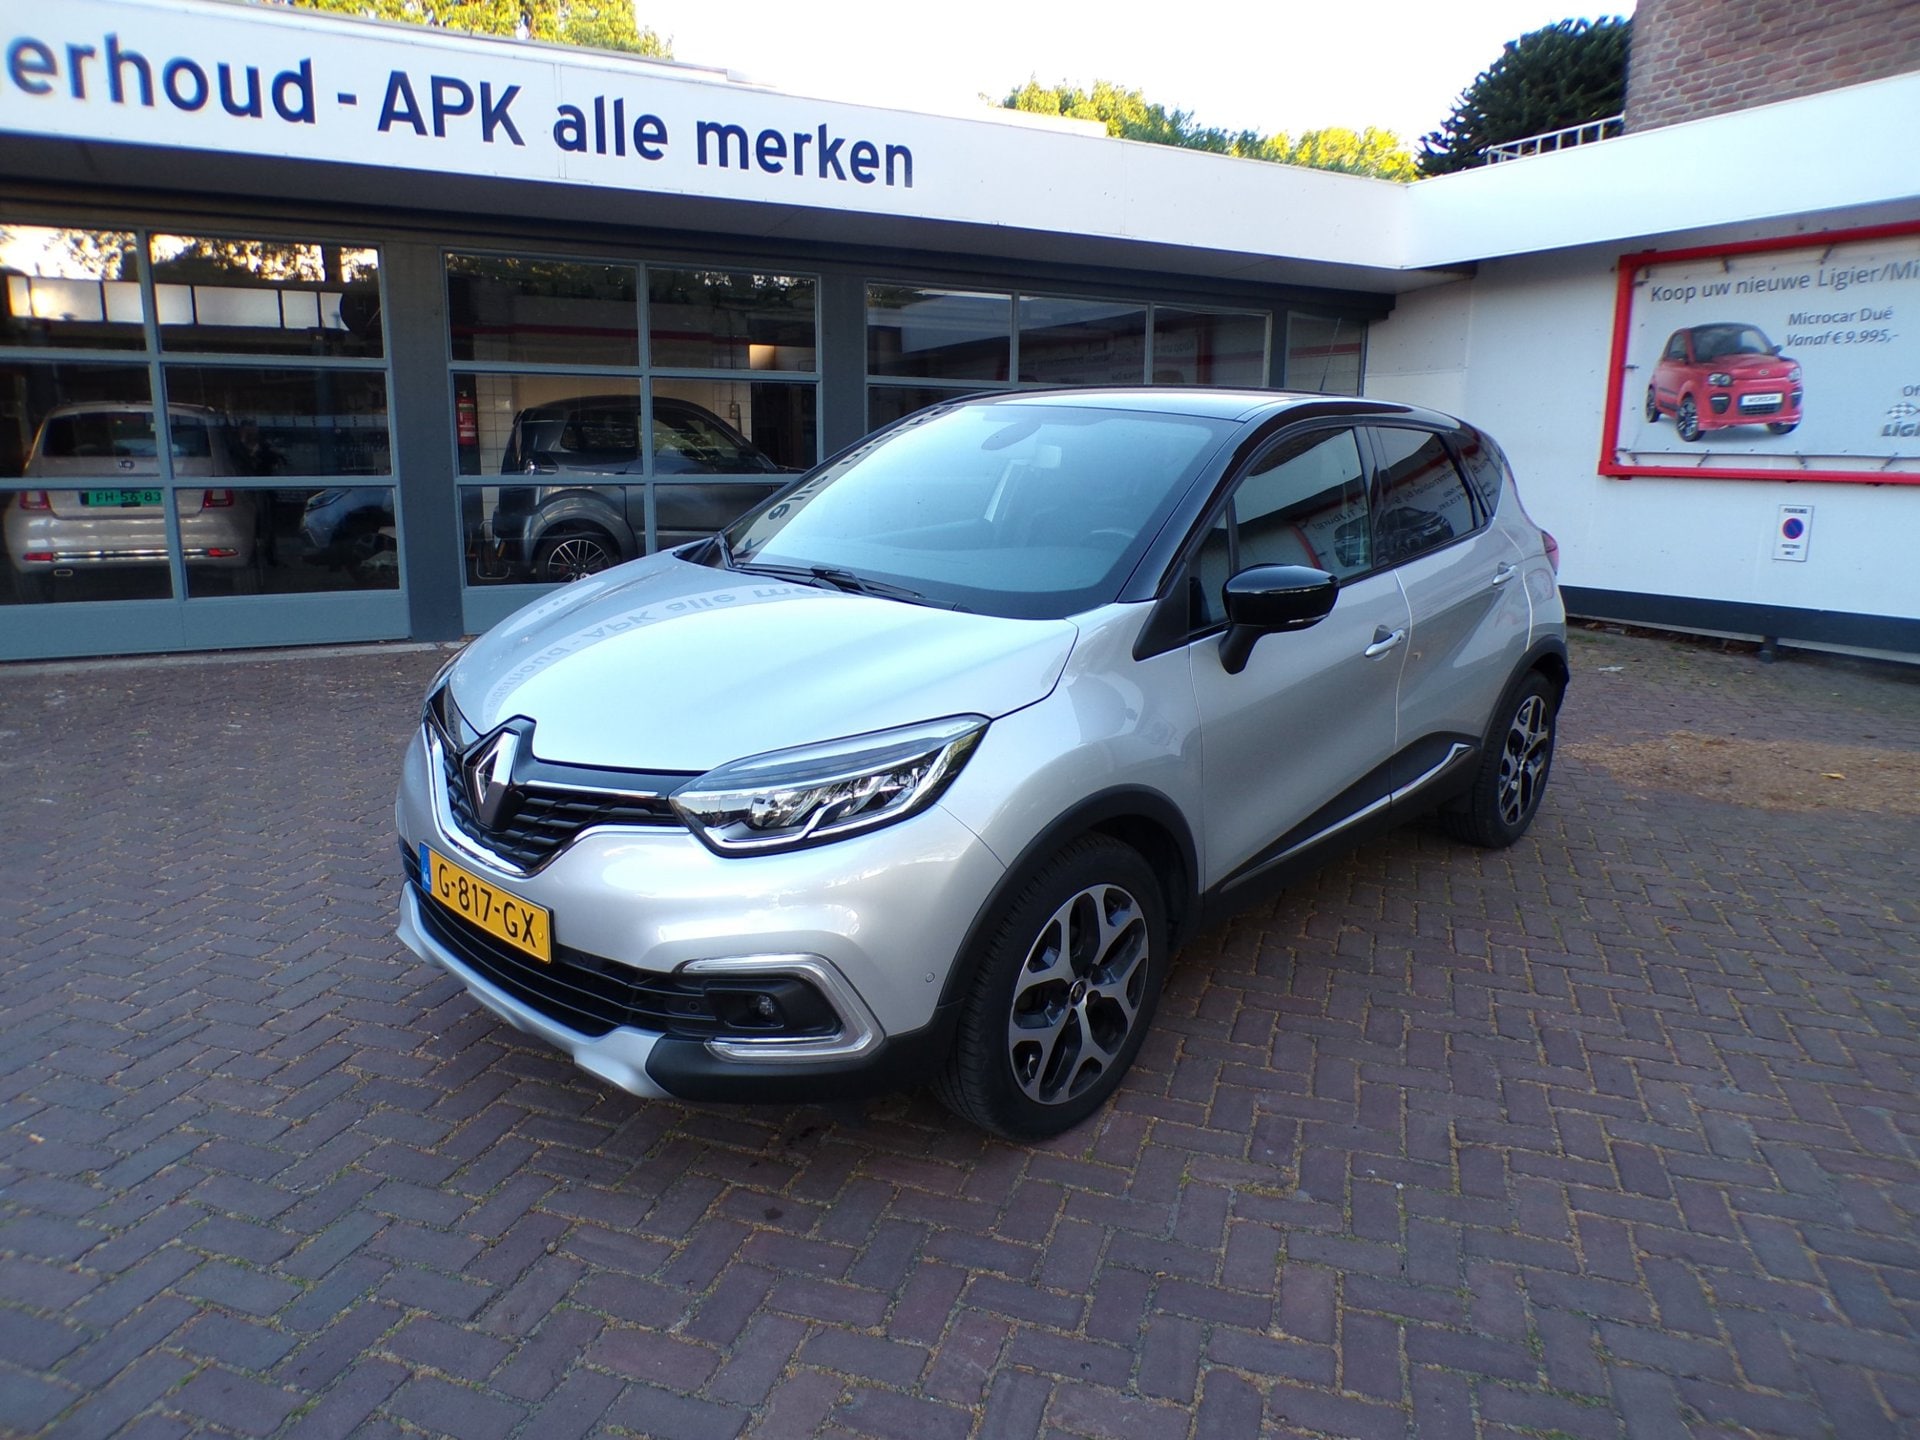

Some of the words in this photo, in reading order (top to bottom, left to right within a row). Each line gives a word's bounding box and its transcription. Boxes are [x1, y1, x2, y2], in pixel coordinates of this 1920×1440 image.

[5, 32, 316, 125] erhoud
[377, 70, 525, 147] APK
[553, 96, 668, 161] alle
[697, 121, 914, 189] merken
[1651, 286, 1697, 304] Koop
[1702, 282, 1731, 298] uw
[1736, 274, 1810, 294] nieuwe
[1788, 312, 1856, 326] Microcar
[1860, 306, 1893, 322] Dué
[1786, 331, 1832, 346] Vanaf
[438, 863, 537, 949] G-817-GX
